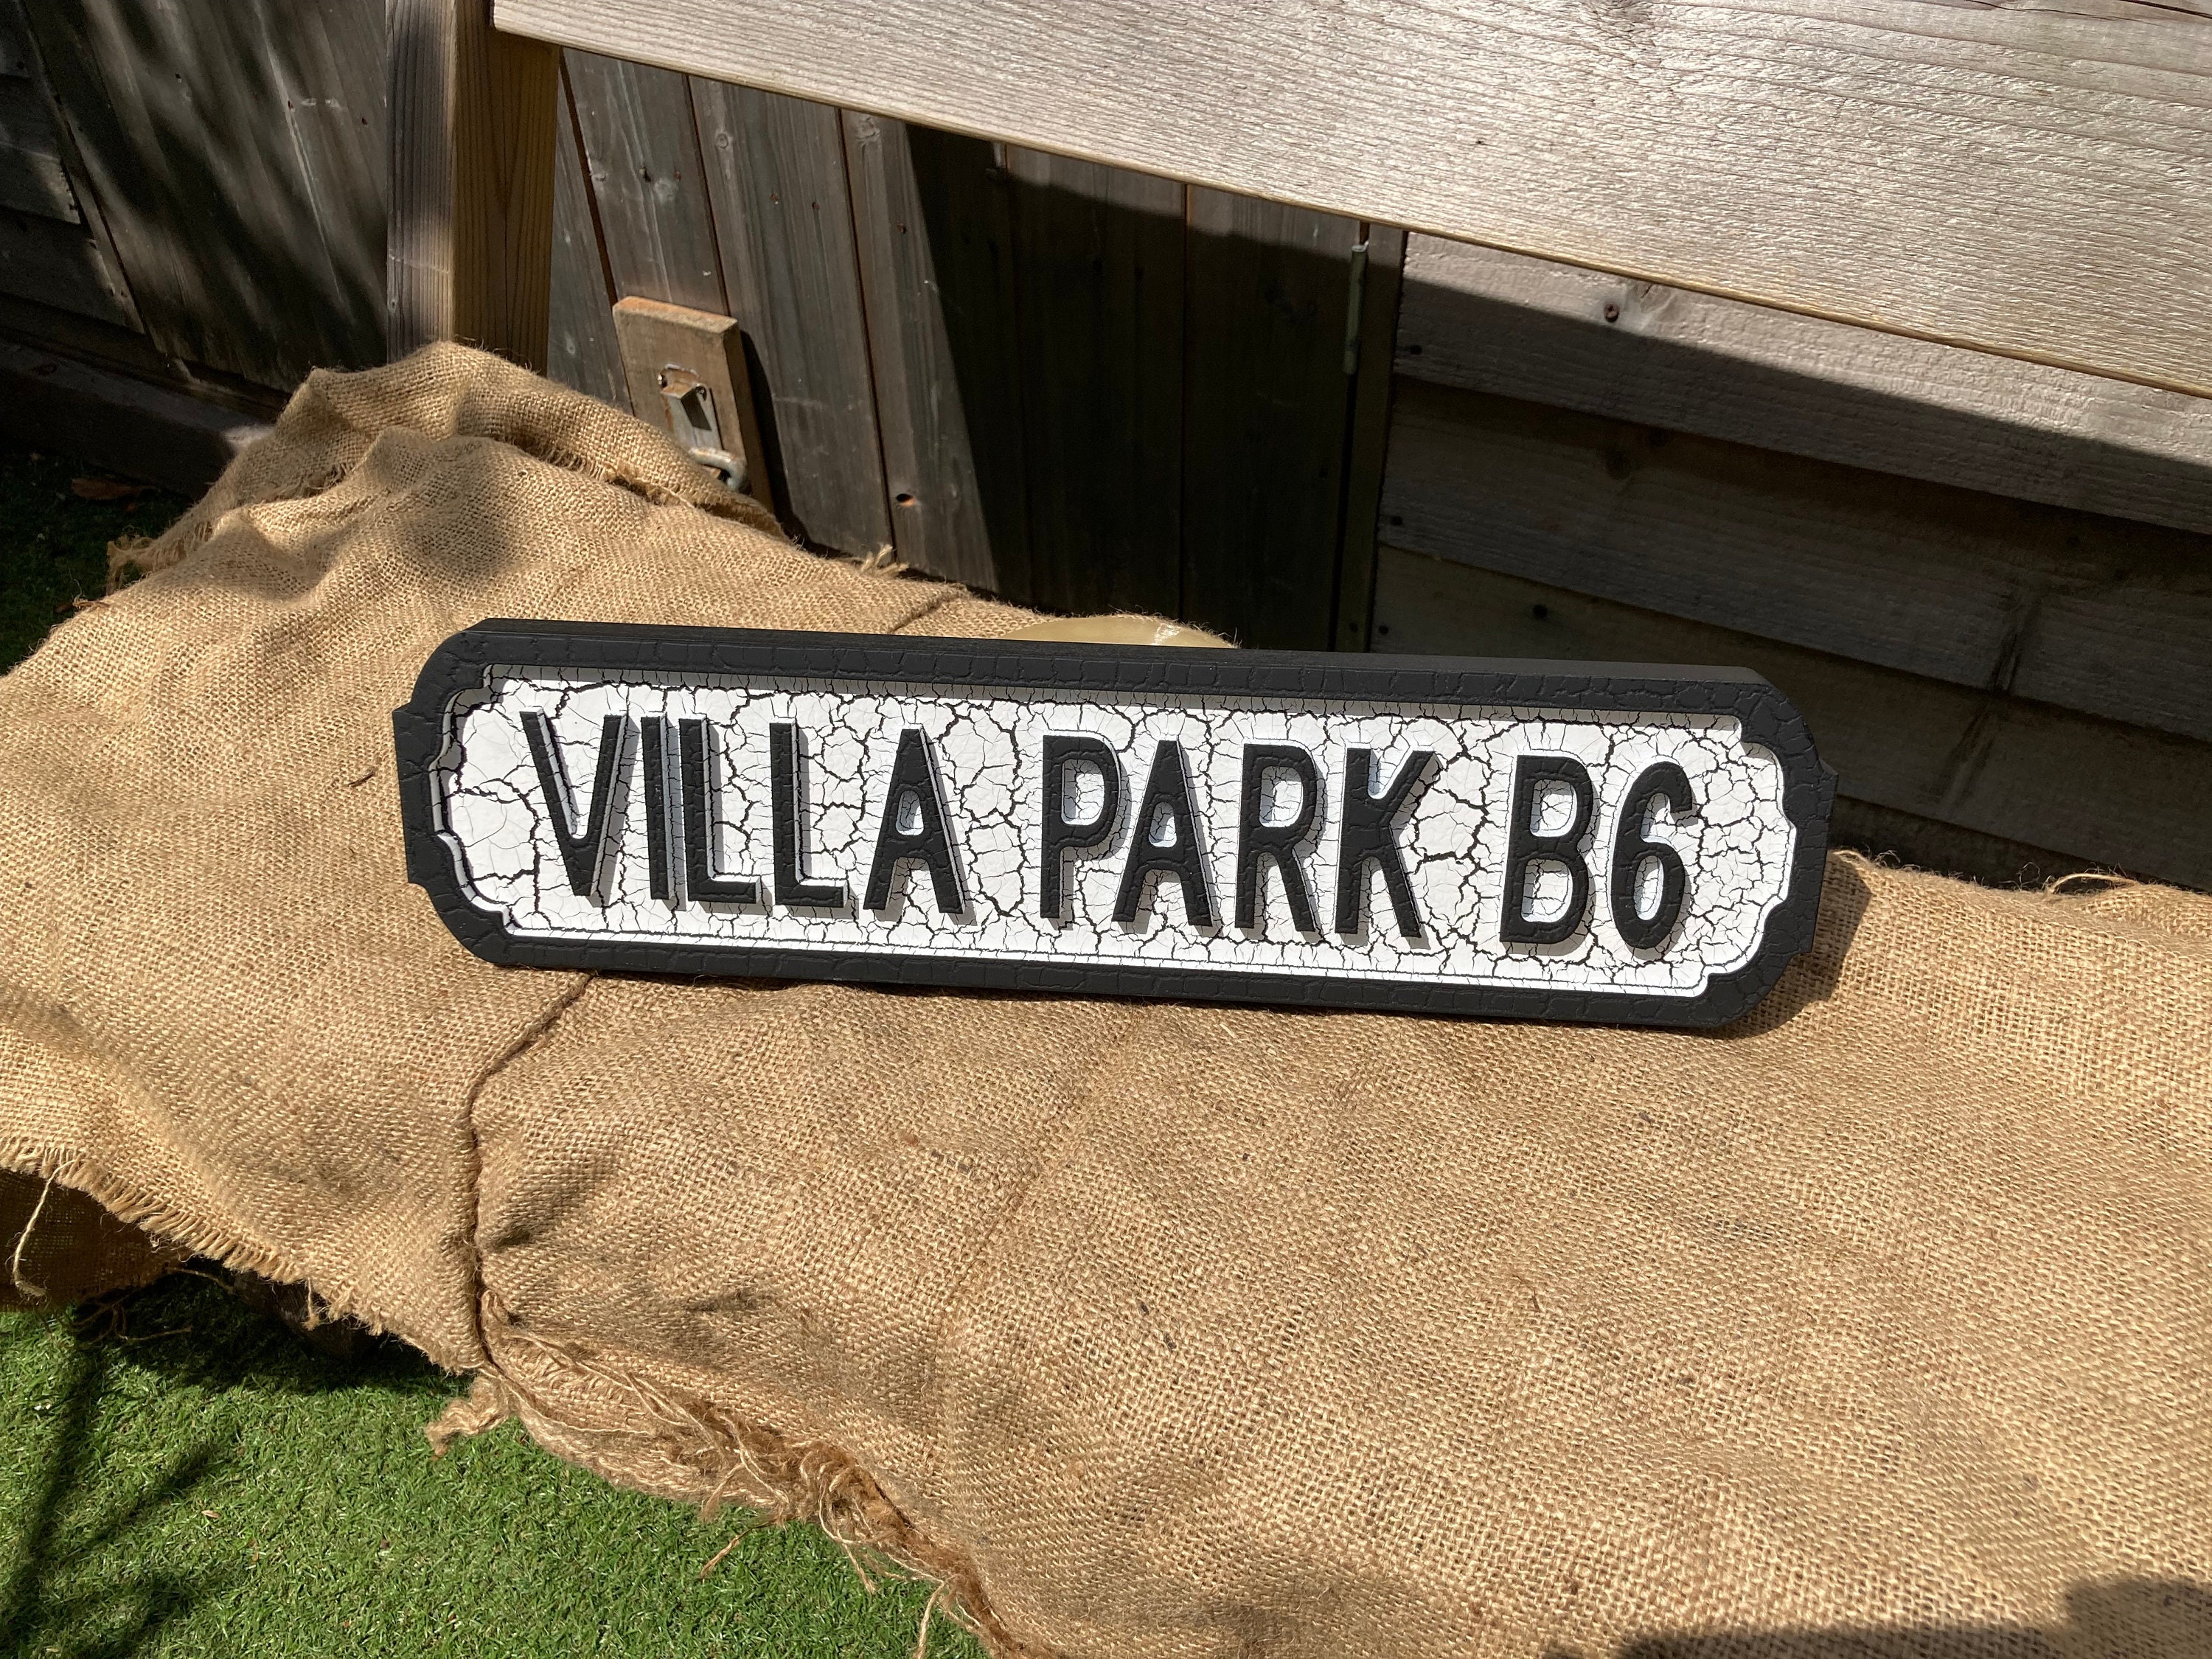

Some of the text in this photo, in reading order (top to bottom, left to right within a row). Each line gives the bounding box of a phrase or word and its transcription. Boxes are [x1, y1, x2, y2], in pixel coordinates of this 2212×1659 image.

[519, 710, 1694, 950] VILLA PARK B6
